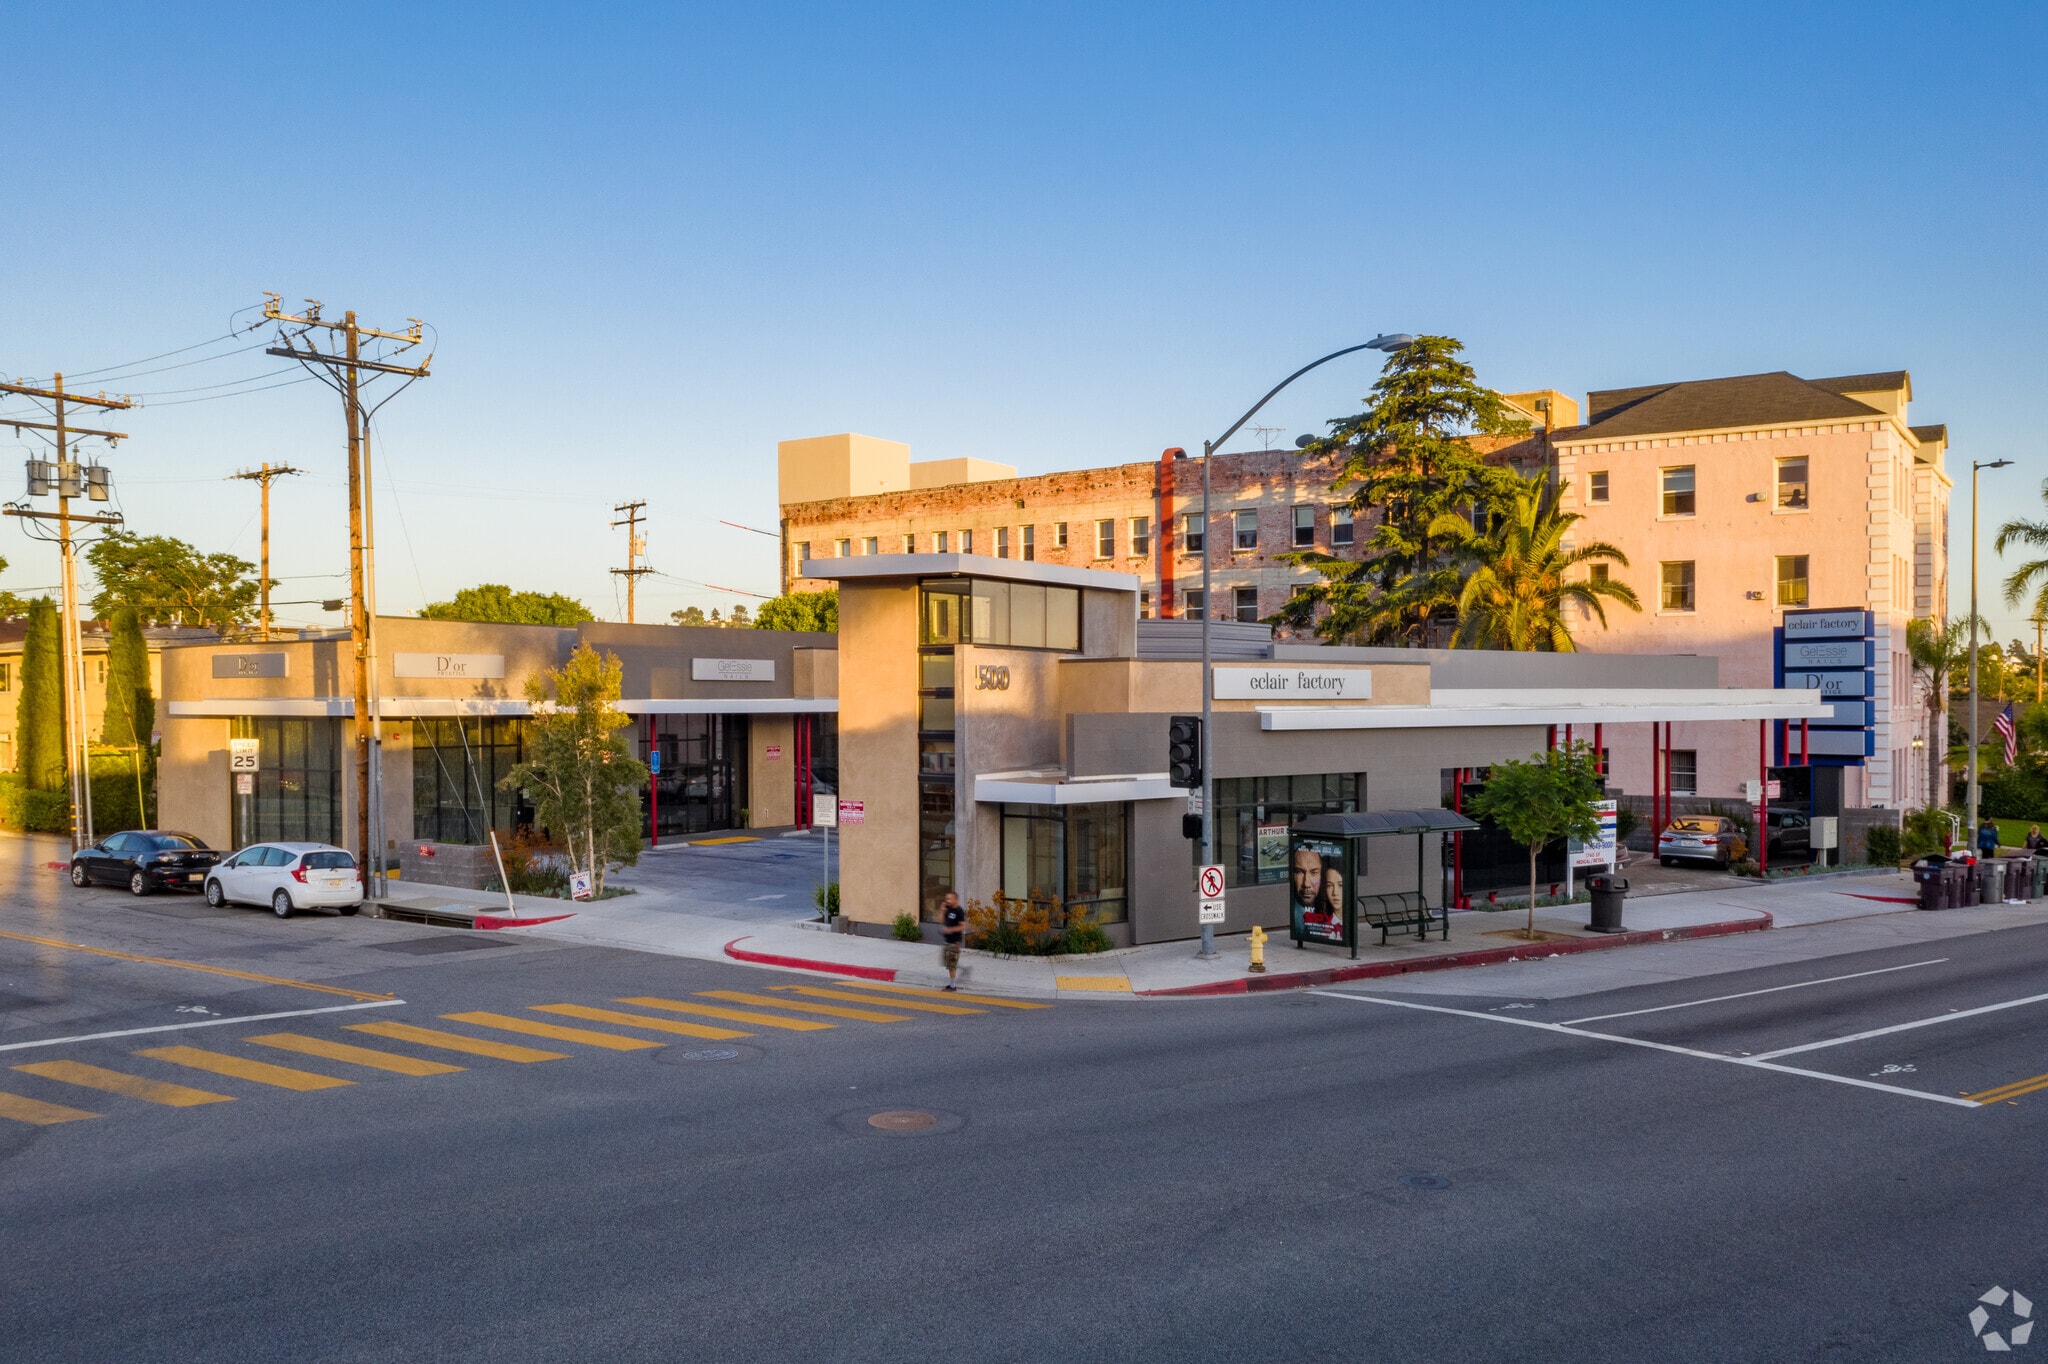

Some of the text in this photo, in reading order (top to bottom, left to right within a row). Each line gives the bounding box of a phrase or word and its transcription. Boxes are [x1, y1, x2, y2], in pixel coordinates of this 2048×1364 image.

[1788, 618, 1859, 632] eclair factory
[436, 656, 467, 672] D'or
[975, 665, 1010, 691] 500
[1250, 671, 1346, 696] eclair factory
[1805, 673, 1844, 690] D'or
[234, 755, 256, 768] 25
[1259, 828, 1285, 836] ARTHUR
[1212, 903, 1222, 911] USE
[1200, 912, 1224, 920] CROSSWALK
[1303, 912, 1334, 925] SPY
